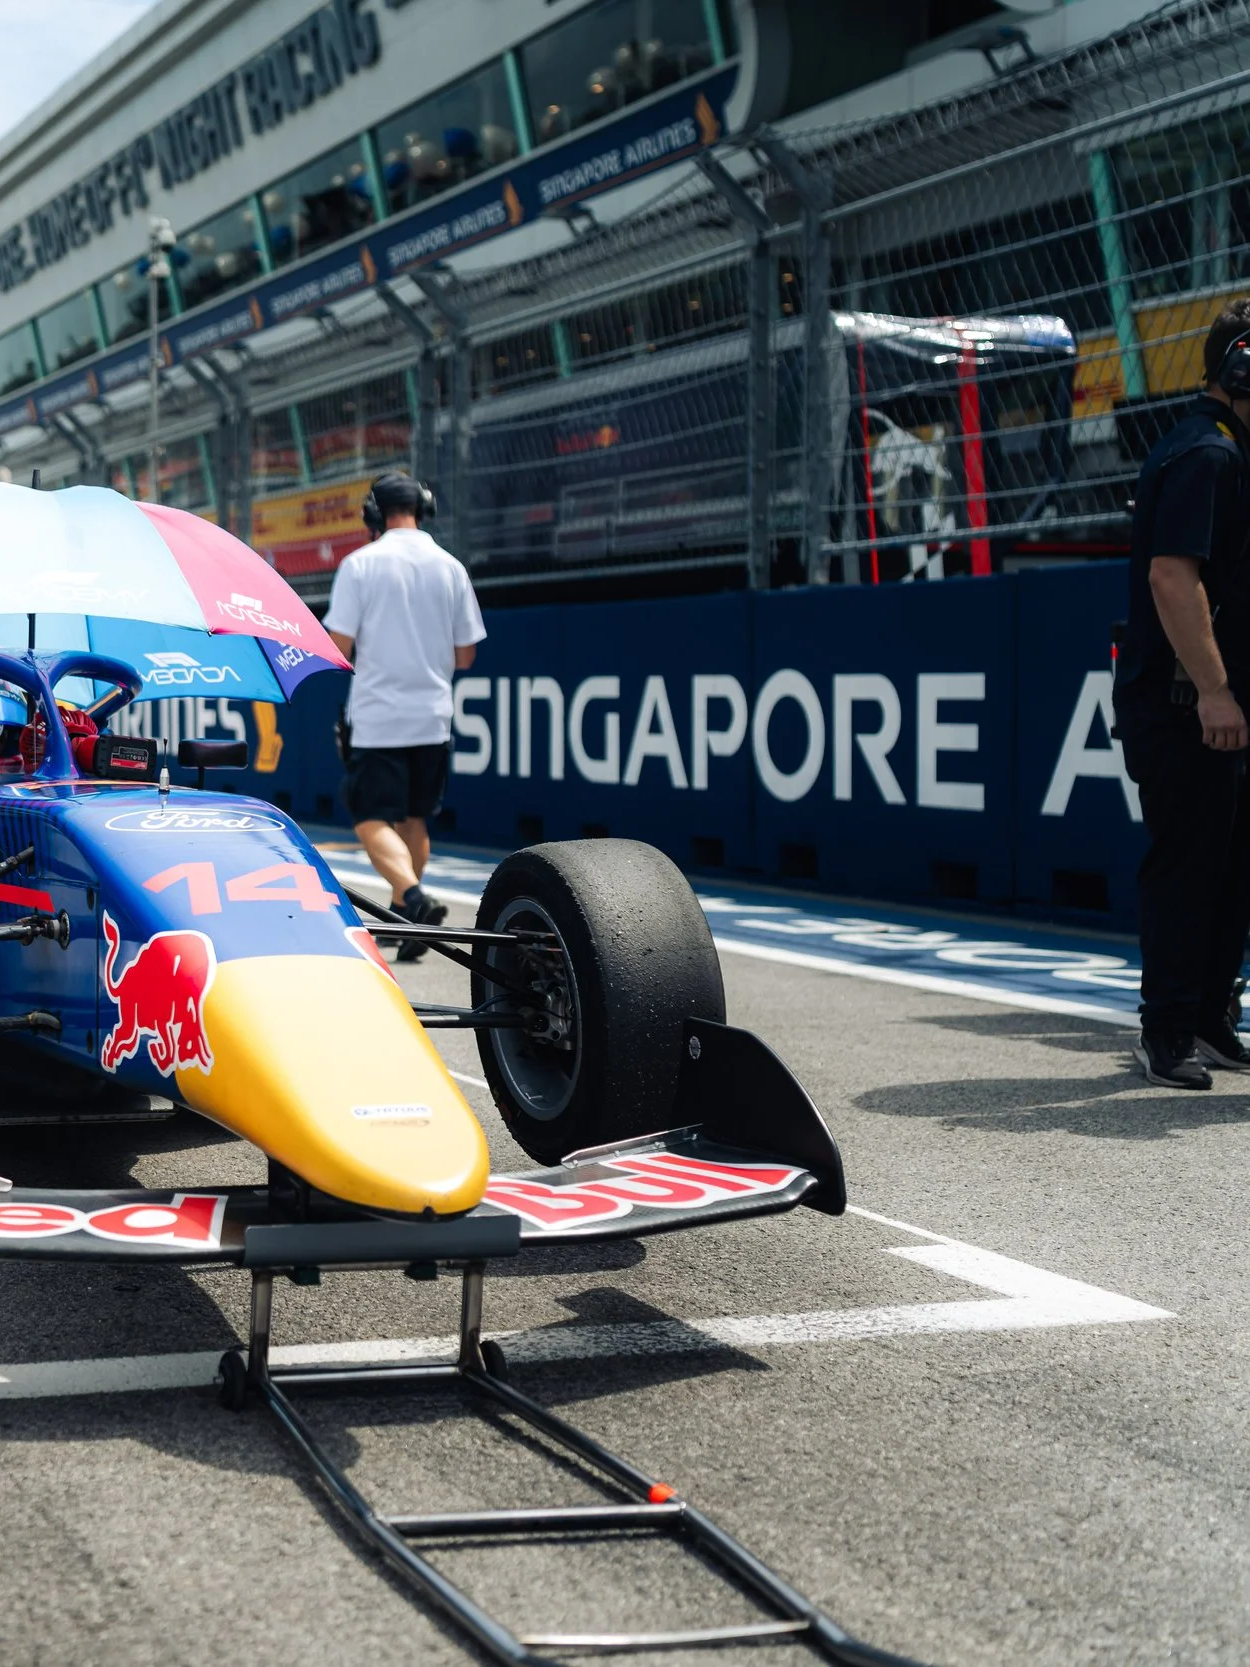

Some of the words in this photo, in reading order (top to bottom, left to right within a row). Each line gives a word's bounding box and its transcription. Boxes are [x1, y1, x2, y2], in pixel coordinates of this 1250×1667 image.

[153, 70, 243, 191] NIGHT
[241, 0, 382, 137] RACING
[538, 149, 624, 204] SINGAPORE
[623, 117, 696, 169] AIRLINES
[216, 600, 302, 637] ACADEMY
[452, 667, 986, 811] SINGAPORE
[140, 811, 255, 830] Ford
[142, 861, 341, 916] 14
[485, 1153, 802, 1227] Bull
